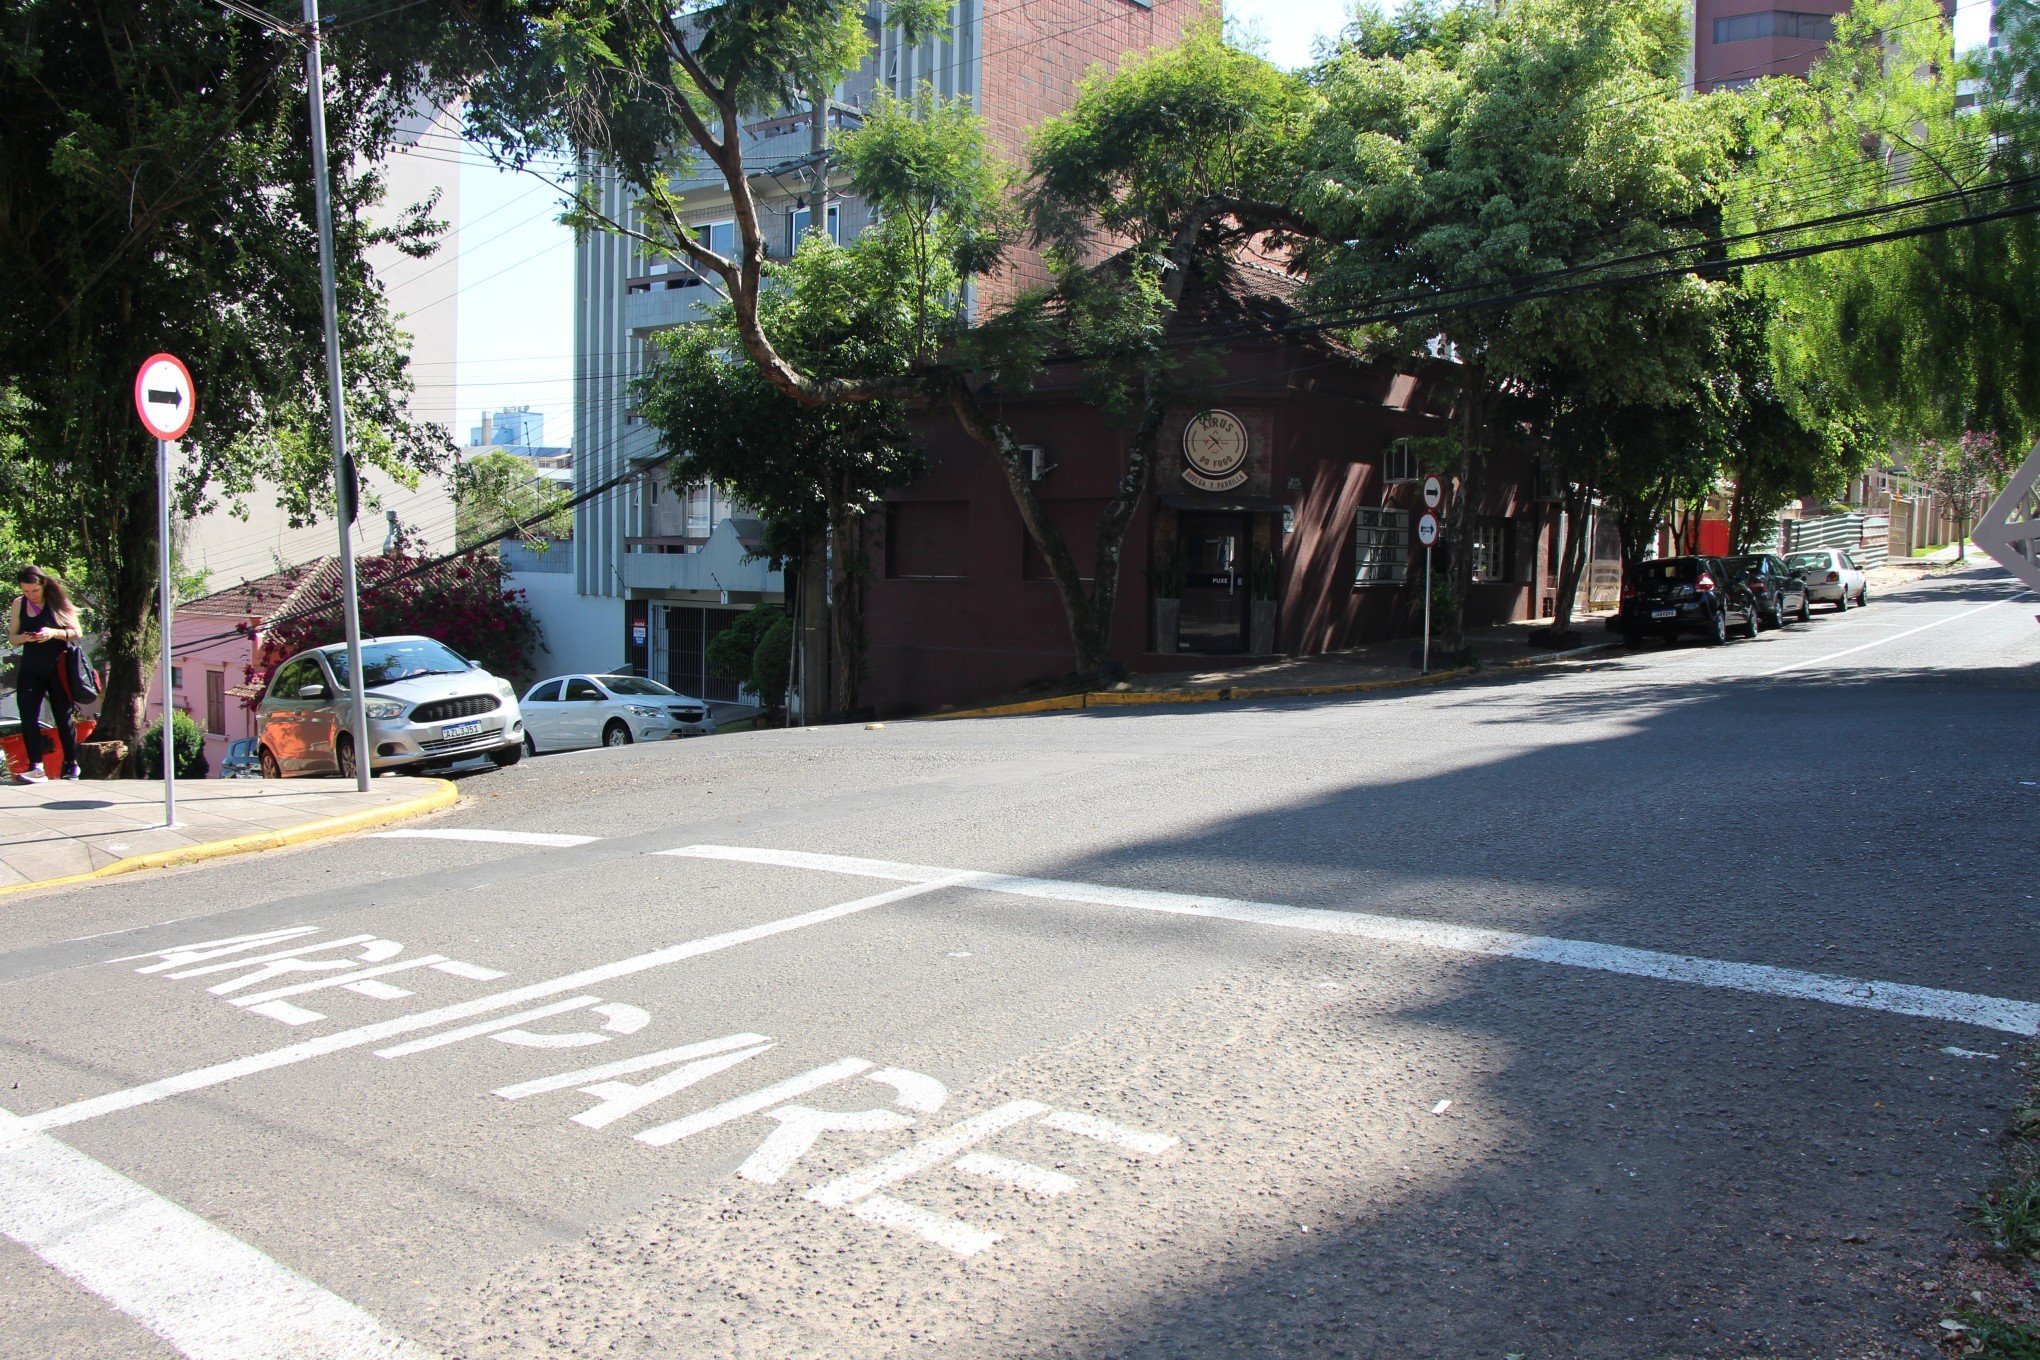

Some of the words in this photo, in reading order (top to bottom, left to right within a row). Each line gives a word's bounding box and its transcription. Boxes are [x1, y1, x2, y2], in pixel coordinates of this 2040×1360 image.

[1199, 417, 1234, 432] XIRUS
[1199, 455, 1210, 465] DO
[1213, 456, 1233, 467] FOGO
[104, 926, 507, 1026] ARE
[373, 995, 1180, 1256] PARE
